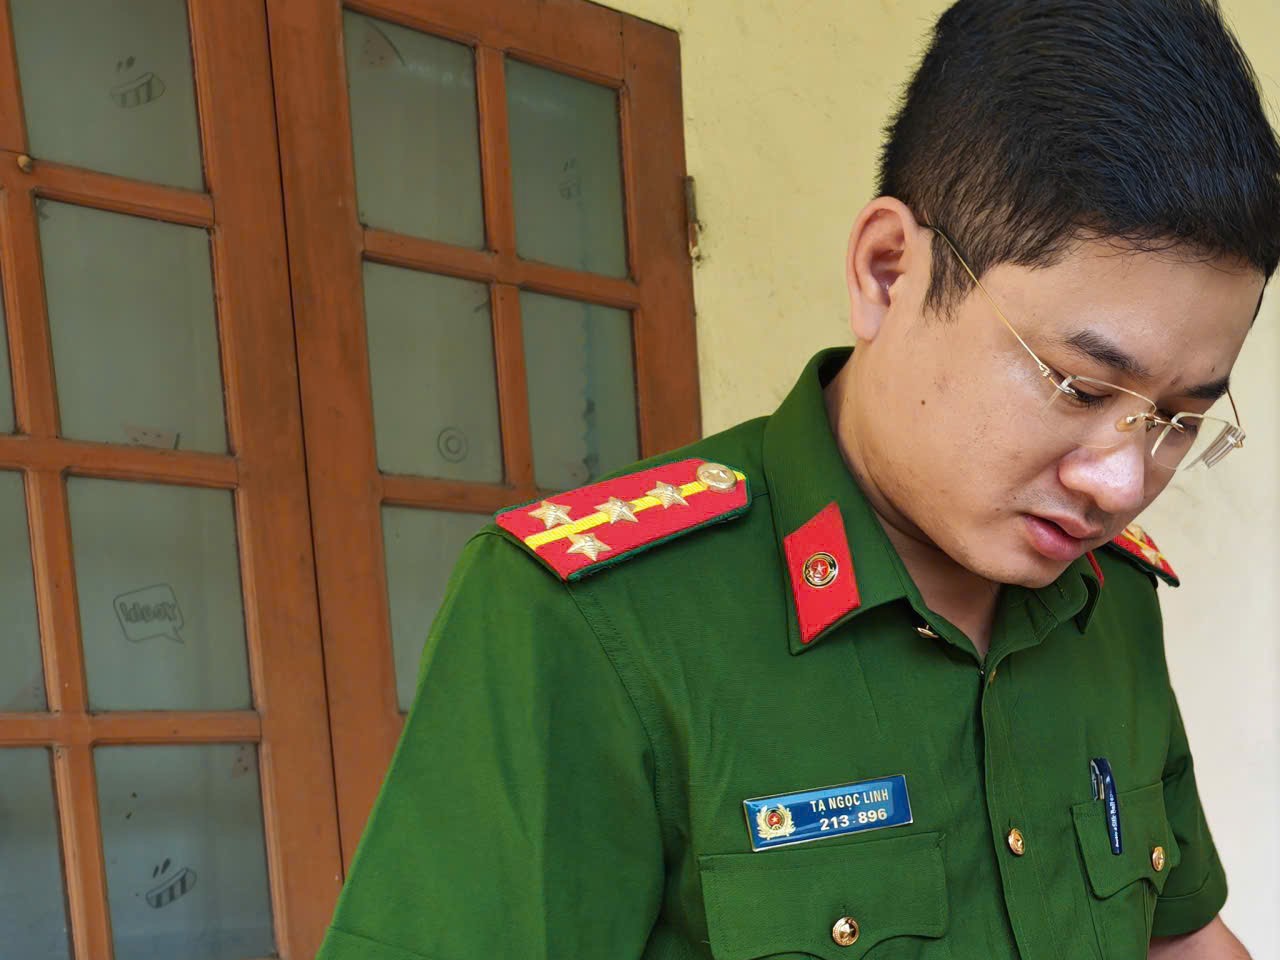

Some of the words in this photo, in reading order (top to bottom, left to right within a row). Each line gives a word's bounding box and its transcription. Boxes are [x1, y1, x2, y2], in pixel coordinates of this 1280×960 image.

[810, 799, 825, 816] TẠ
[828, 793, 860, 811] NGỌC
[863, 788, 889, 804] LINH
